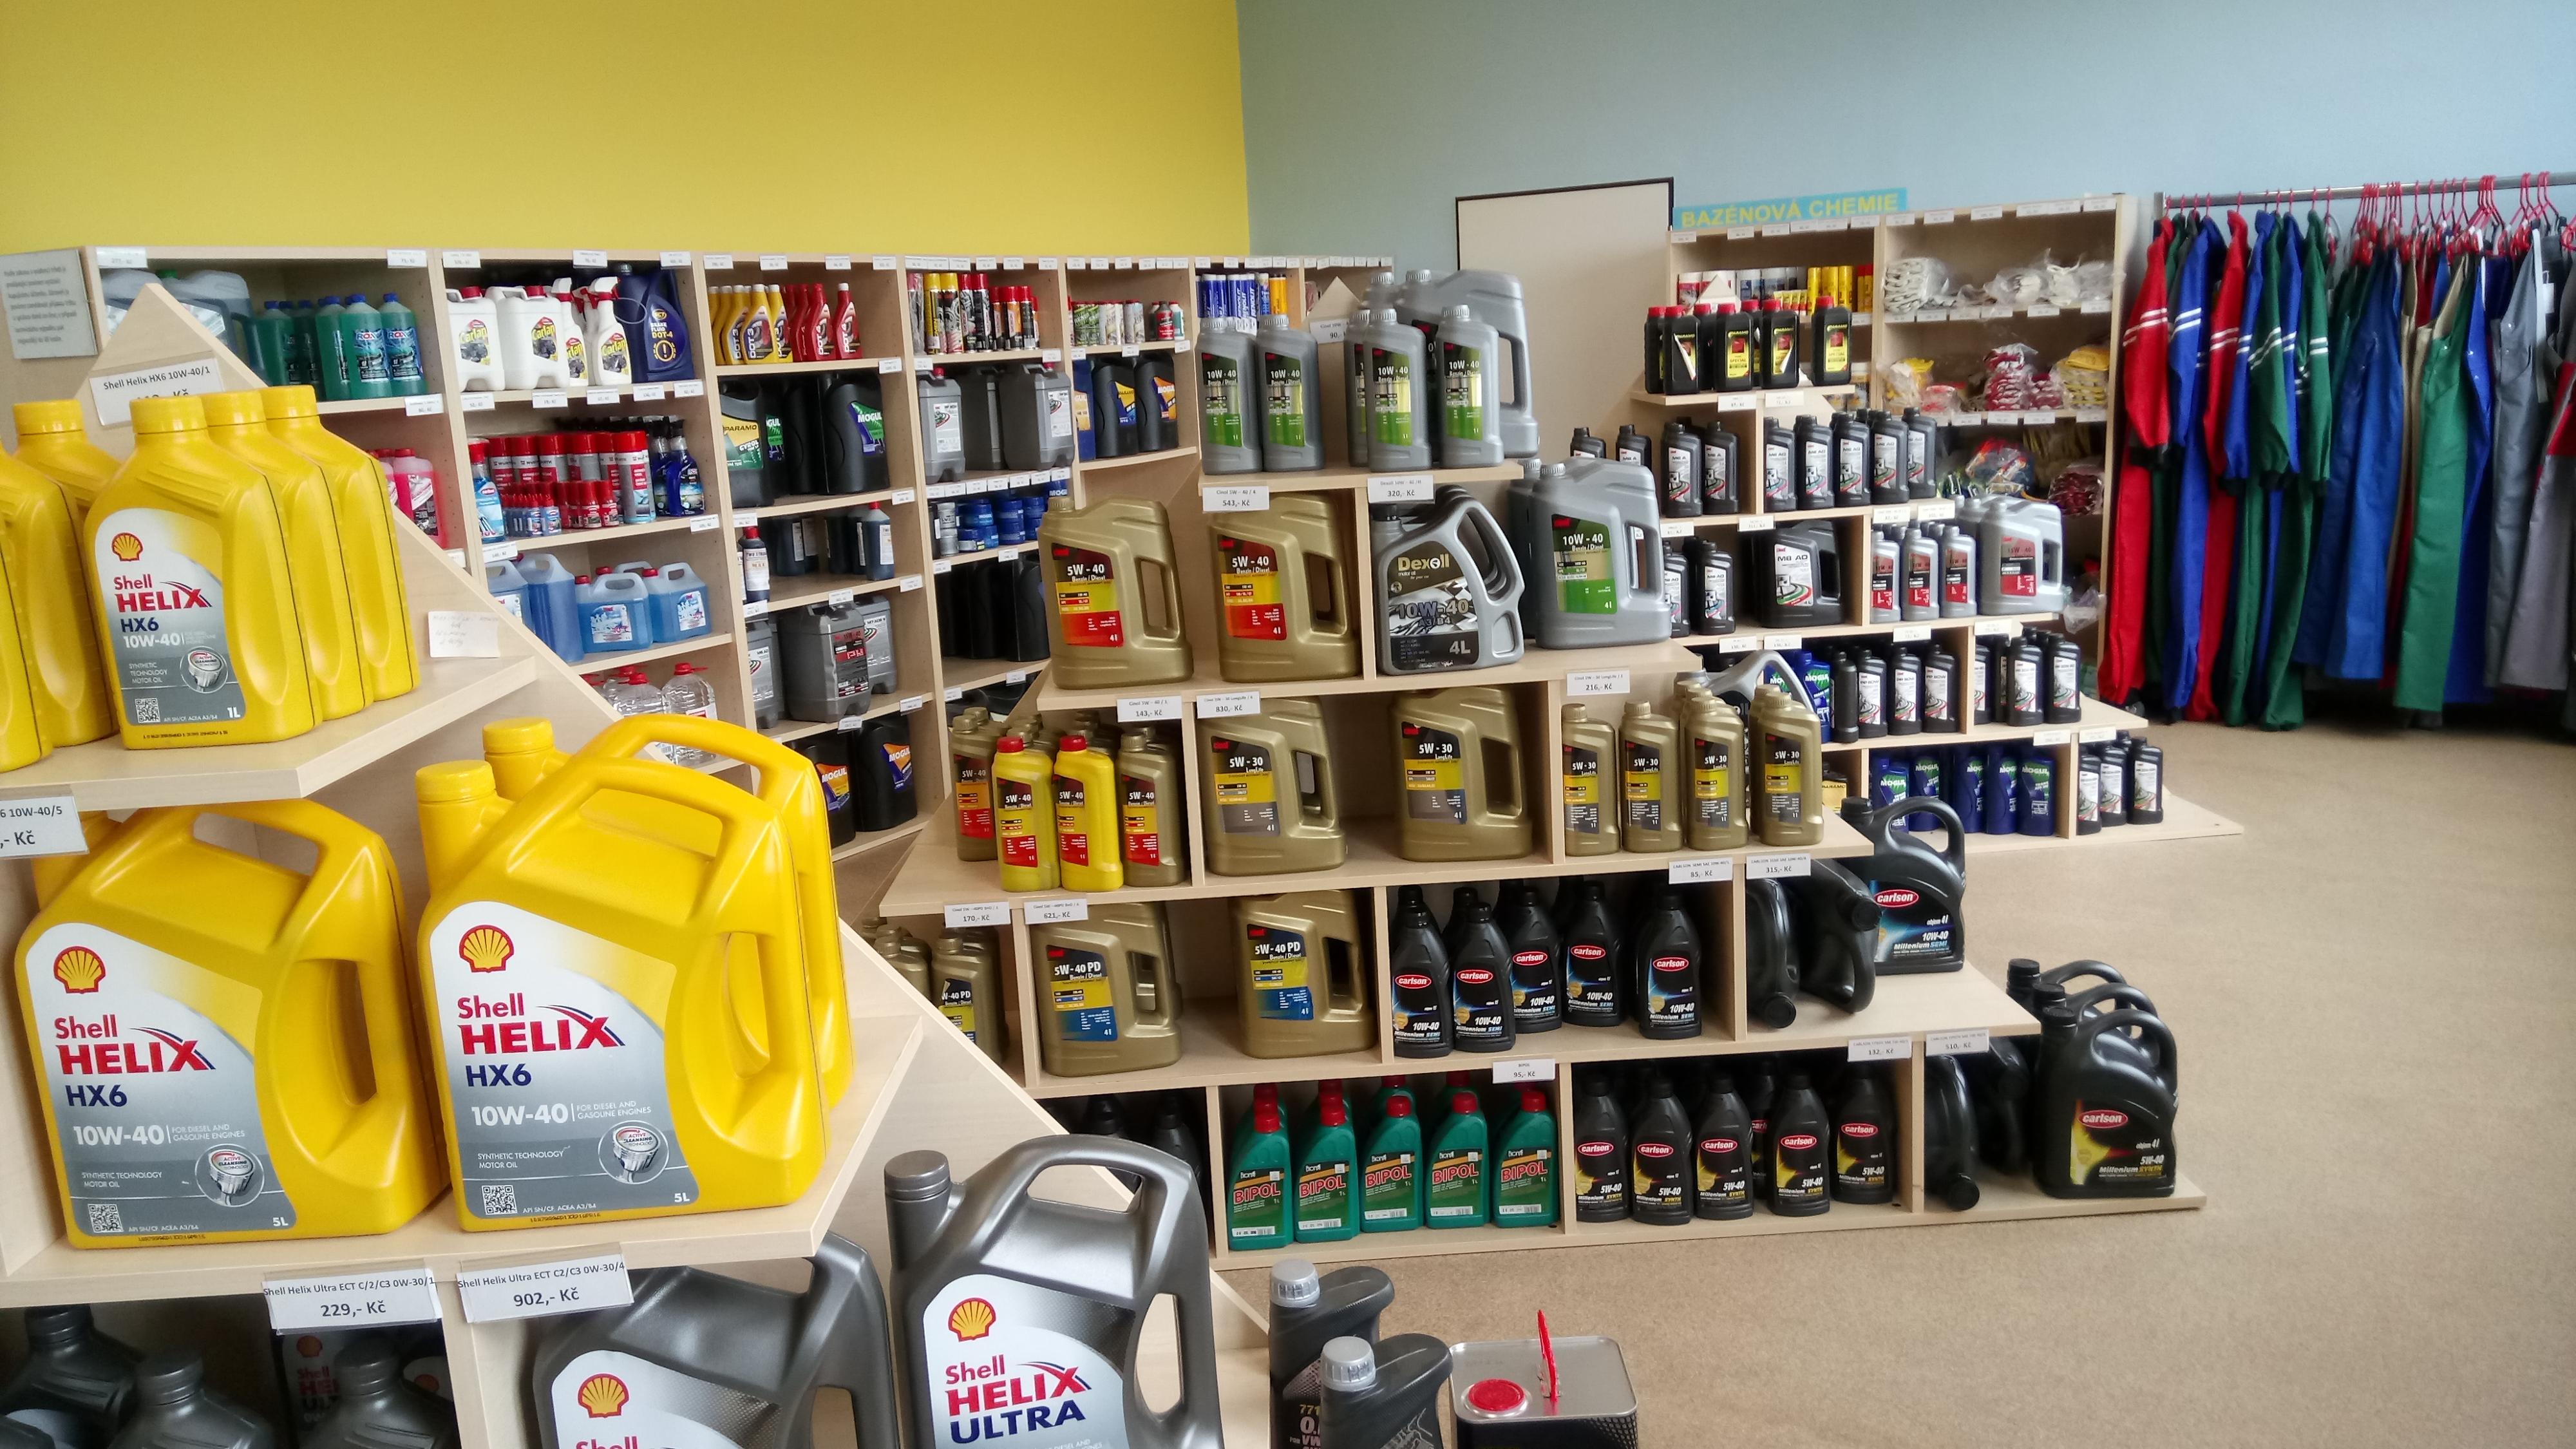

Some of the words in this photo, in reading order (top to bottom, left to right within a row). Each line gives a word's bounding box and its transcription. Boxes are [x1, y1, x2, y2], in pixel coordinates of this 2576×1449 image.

[1681, 201, 1801, 228] BAZÉNOVÁ
[1810, 194, 1898, 218] CHEMIE
[104, 380, 124, 390] Shell
[127, 377, 147, 386] Helix
[149, 374, 166, 383] HX6
[169, 366, 211, 379] 10W-40/1
[858, 412, 882, 423] MOGUL
[724, 424, 757, 434] PARAMO
[1387, 489, 1405, 498] 320,-
[1222, 499, 1240, 507] 543,-
[1397, 554, 1449, 571] Dexoll
[113, 574, 152, 590] Shell
[116, 585, 211, 612] HELIX
[1396, 599, 1468, 619] 10W-40
[120, 618, 159, 632] HX6
[1418, 616, 1451, 627] A3/B4
[124, 632, 181, 649] 10W-40
[1450, 640, 1471, 654] 4L
[1805, 674, 1830, 683] MOGUL
[227, 707, 240, 718] 1L
[889, 747, 911, 762] MOGUL
[822, 768, 846, 783] MOGUL
[1880, 777, 1906, 786] MOGUL
[9, 805, 62, 817] 10W-40/5
[14, 830, 35, 845] Kč
[1877, 893, 1915, 904] carlson
[1922, 931, 1949, 941] 10W-40
[1516, 953, 1544, 962] carlson
[1573, 947, 1602, 956] carlson
[1656, 959, 1685, 968] carlson
[1398, 976, 1427, 985] carlson
[1459, 971, 1489, 980] carlson
[1530, 996, 1555, 1005] 10W-40
[1587, 992, 1613, 1001] 10W-40
[457, 992, 524, 1019] Shell
[1669, 1003, 1694, 1012] 10W-40
[55, 1014, 117, 1039] Shell
[457, 1009, 625, 1055] HELIX
[56, 1034, 215, 1074] HELIX
[466, 1063, 532, 1086] HX6
[65, 1084, 128, 1107] HX6
[578, 1110, 616, 1119] GASOLINE
[618, 1106, 651, 1116] ENGINES
[593, 1102, 616, 1110] DIESEL
[471, 1103, 569, 1126] 10W-40
[2082, 1113, 2123, 1124] carlson
[74, 1125, 164, 1146] 10W-40
[173, 1133, 211, 1141] GASOLINE
[212, 1131, 245, 1139] ENGINES
[1845, 1125, 1874, 1134] carlson
[1705, 1141, 1733, 1150] carlson
[1784, 1137, 1813, 1146] carlson
[1581, 1144, 1609, 1153] carlson
[1640, 1146, 1669, 1154] carlson
[2141, 1155, 2164, 1165] 5W-40
[1365, 1166, 1411, 1188] BIPOL
[1432, 1162, 1479, 1184] BIPOL
[1501, 1161, 1548, 1183] BIPOL
[1300, 1175, 1346, 1197] BIPOL
[1723, 1180, 1745, 1190] 5W-40
[1803, 1177, 1823, 1187] 5W-40
[674, 1193, 690, 1202] 5L
[1233, 1182, 1280, 1204] BIPOL
[272, 1217, 289, 1226] 5L
[458, 1279, 480, 1288] Shell
[483, 1276, 507, 1285] Helix
[509, 1274, 531, 1283] Ultra
[535, 1271, 551, 1280] ECT
[554, 1267, 581, 1278] C2/C3
[583, 1262, 625, 1274] 0W-30/4
[264, 1287, 286, 1296] Shell
[289, 1286, 312, 1294] Helix
[314, 1284, 337, 1293] Ultra
[339, 1282, 355, 1291] ECT
[358, 1280, 391, 1291] C/2/C3
[393, 1277, 434, 1288] 0W-30/1
[513, 1293, 555, 1307] 902,-
[560, 1287, 580, 1302] Kč
[321, 1303, 362, 1318] 229,-
[366, 1300, 386, 1314] Kč
[297, 1366, 330, 1379] Shell
[945, 1354, 1005, 1385] Shell
[945, 1365, 1092, 1416] HELIX
[950, 1399, 1086, 1444] ULTRA
